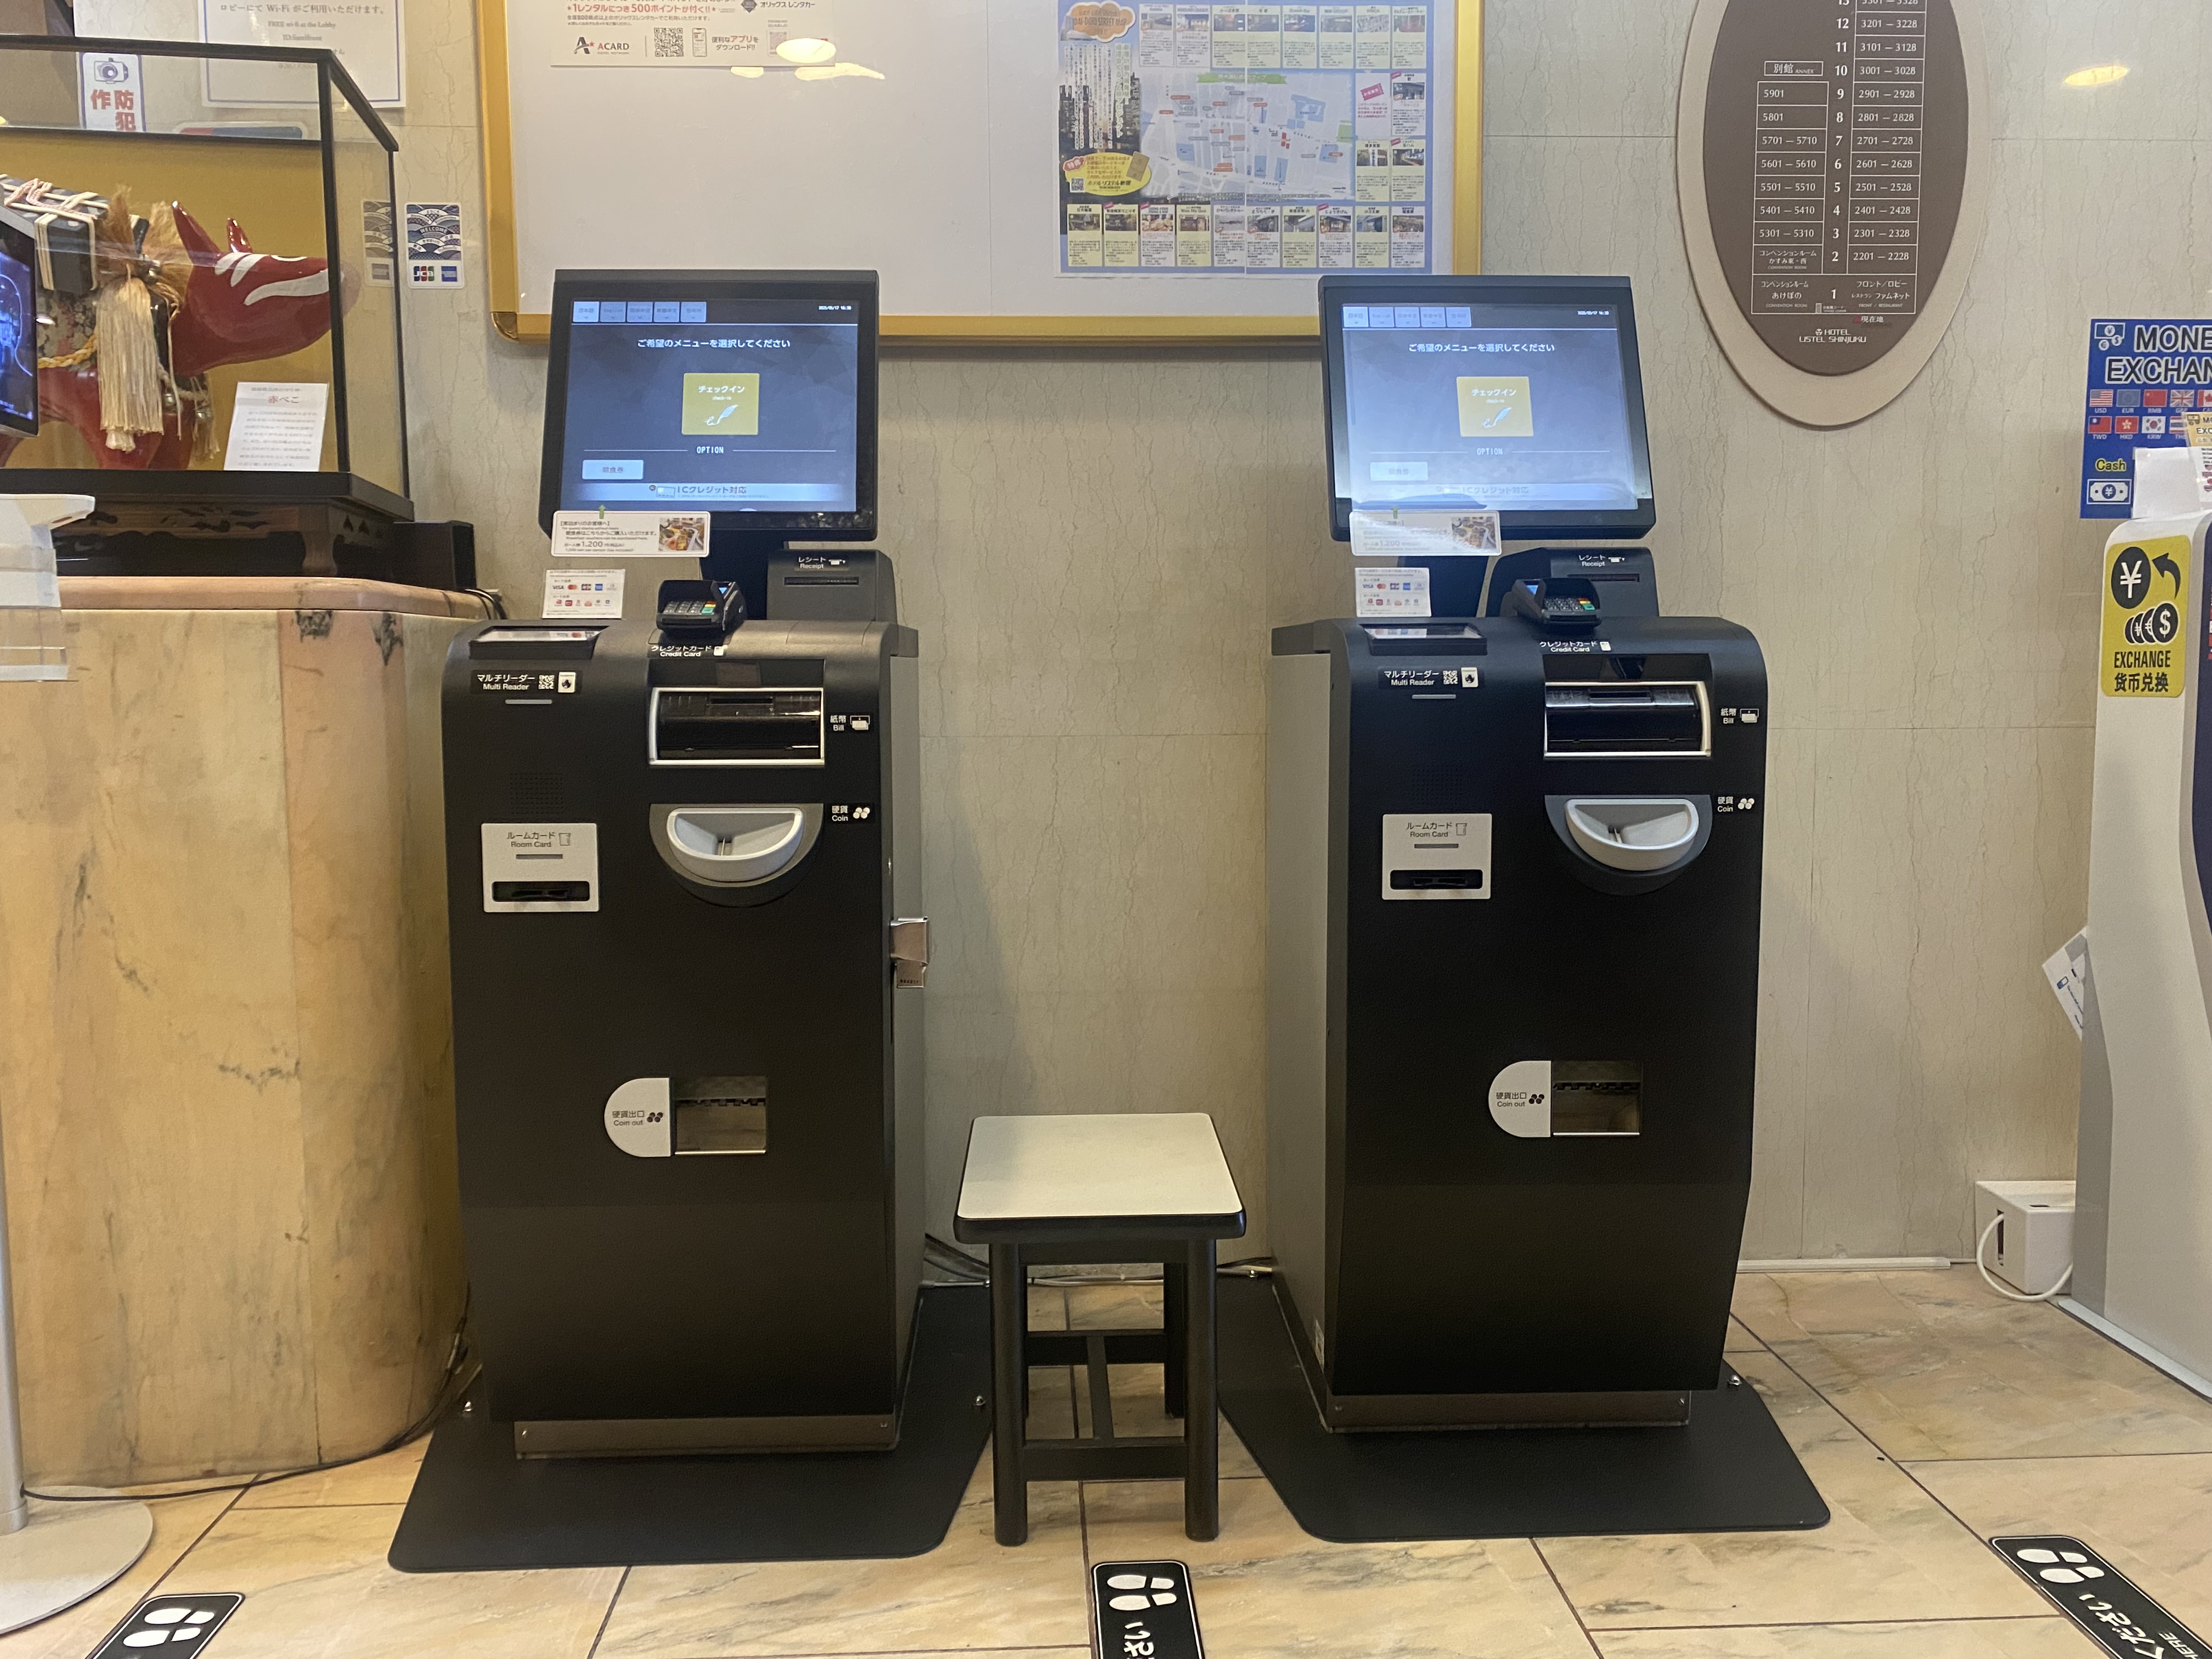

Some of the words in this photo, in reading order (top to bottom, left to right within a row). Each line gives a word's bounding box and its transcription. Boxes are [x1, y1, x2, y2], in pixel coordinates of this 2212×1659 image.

[1837, 18, 1849, 29] 12
[1861, 20, 1882, 28] 3201
[1897, 20, 1917, 28] 3228
[1836, 42, 1847, 53] 11
[1860, 43, 1881, 52] 3101
[1895, 43, 1916, 52] 3128
[1773, 63, 1793, 74] 別館
[1835, 65, 1848, 76] 10
[1860, 66, 1880, 75] 3001
[1894, 66, 1915, 75] 3028
[1764, 89, 1784, 98] 5901
[1837, 88, 1844, 99] 9
[1859, 89, 1879, 98] 2901
[1894, 89, 1915, 98] 2928
[1763, 113, 1783, 121] 5801
[1836, 112, 1843, 122] 8
[1858, 113, 1878, 121] 2801
[1893, 113, 1914, 121] 2828
[1762, 136, 1782, 145] 5701
[1797, 136, 1817, 145] 5710
[1835, 136, 1843, 145] 7
[1857, 136, 1877, 145] 2701
[1892, 136, 1913, 145] 2728
[1762, 160, 1781, 168] 5601
[1796, 160, 1816, 168] 5610
[1835, 159, 1842, 169] 6
[1856, 160, 1877, 168] 2601
[1891, 160, 1912, 168] 2628
[1760, 183, 1781, 191] 5501
[1795, 183, 1815, 191] 5510
[1834, 182, 1841, 192] 5
[1855, 183, 1876, 191] 2501
[1891, 183, 1911, 191] 2528
[1833, 206, 1840, 215] 4
[1832, 228, 1839, 238] 3
[1832, 252, 1838, 262] 2
[1853, 252, 1874, 261] 2201
[1888, 252, 1909, 261] 2228
[1831, 289, 1837, 299] 1
[637, 338, 791, 348] ご希望のメニューを選択してください
[1408, 343, 1555, 353] ご希望のメニューを選択してください
[2096, 459, 2126, 471] Cash
[2114, 651, 2171, 668] EXCHANGE
[477, 674, 535, 683] マルチリーダー
[1384, 670, 1439, 679] マルチリーダー
[2114, 672, 2169, 692] 货币兑换
[830, 715, 846, 723] 紙幣
[832, 805, 848, 814] 硬貨
[1406, 822, 1453, 830] ルームカード
[507, 831, 556, 840] ルームカード
